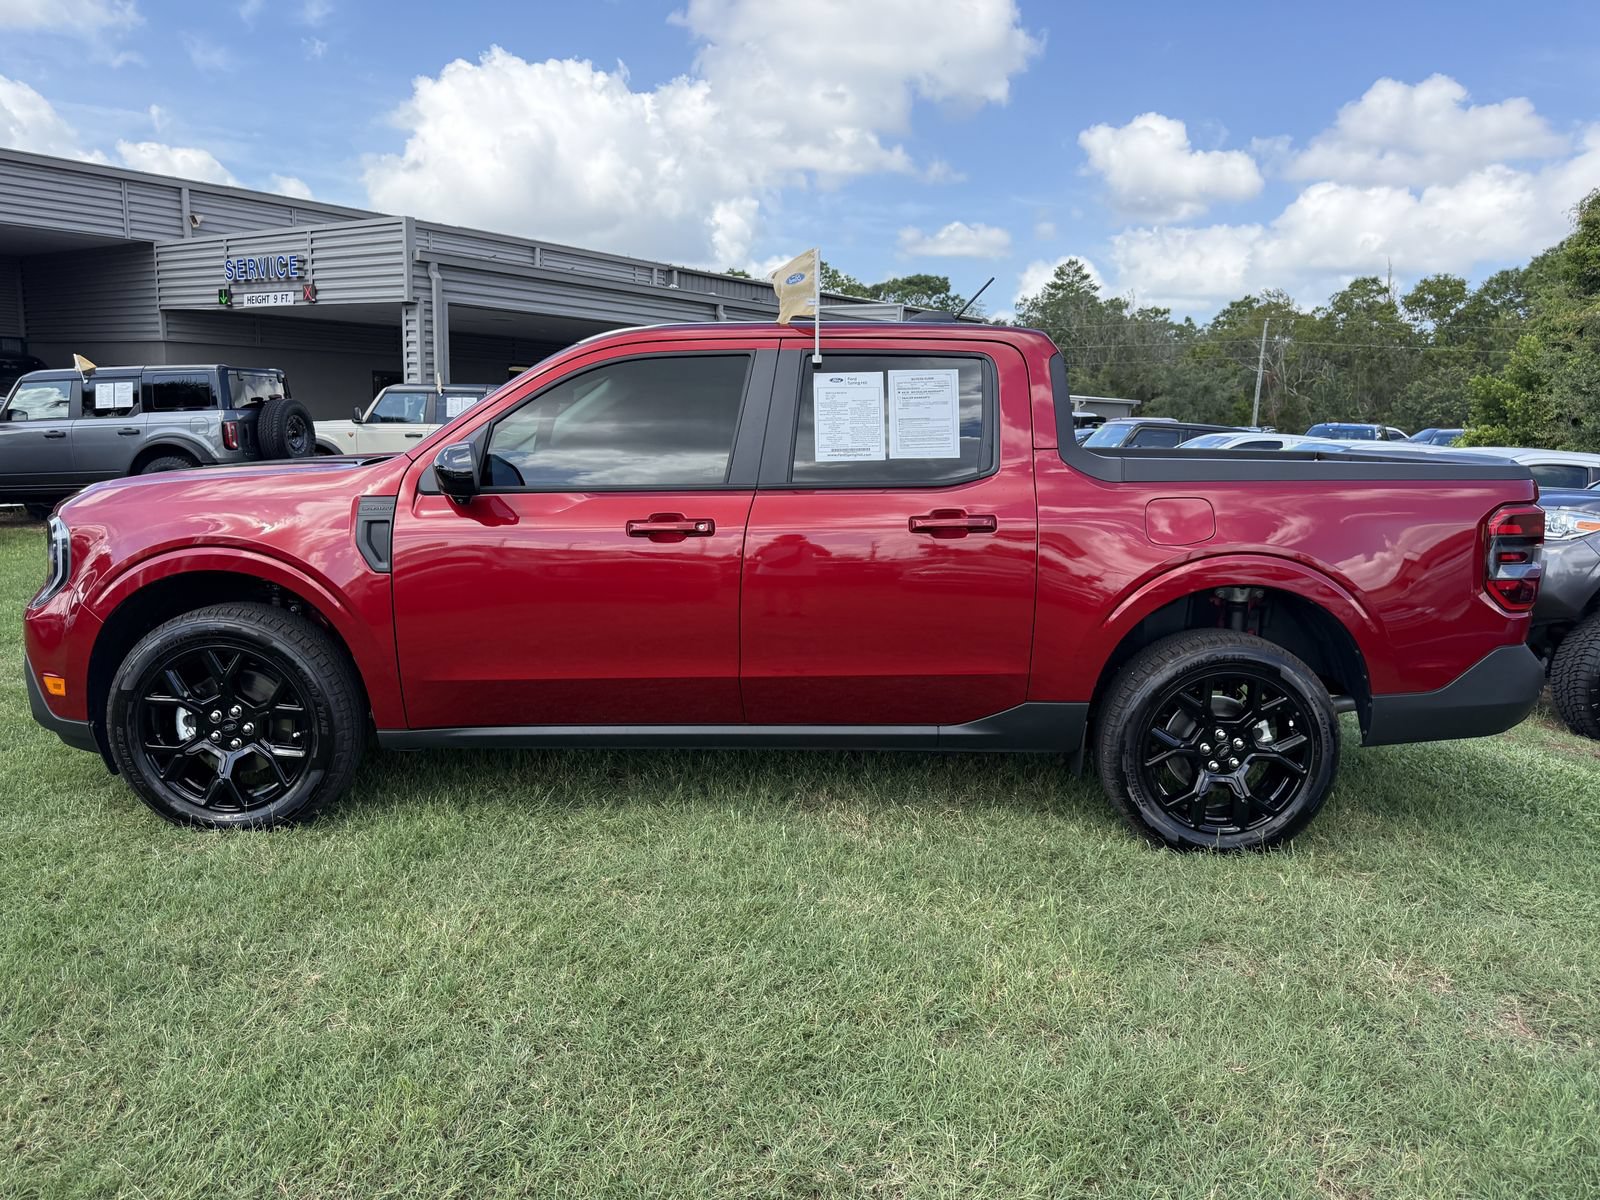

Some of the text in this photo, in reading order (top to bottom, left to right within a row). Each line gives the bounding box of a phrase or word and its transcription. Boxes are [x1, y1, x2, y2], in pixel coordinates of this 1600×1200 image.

[225, 254, 299, 281] SERVICE
[247, 294, 291, 305] HEIGHT 9 FT.
